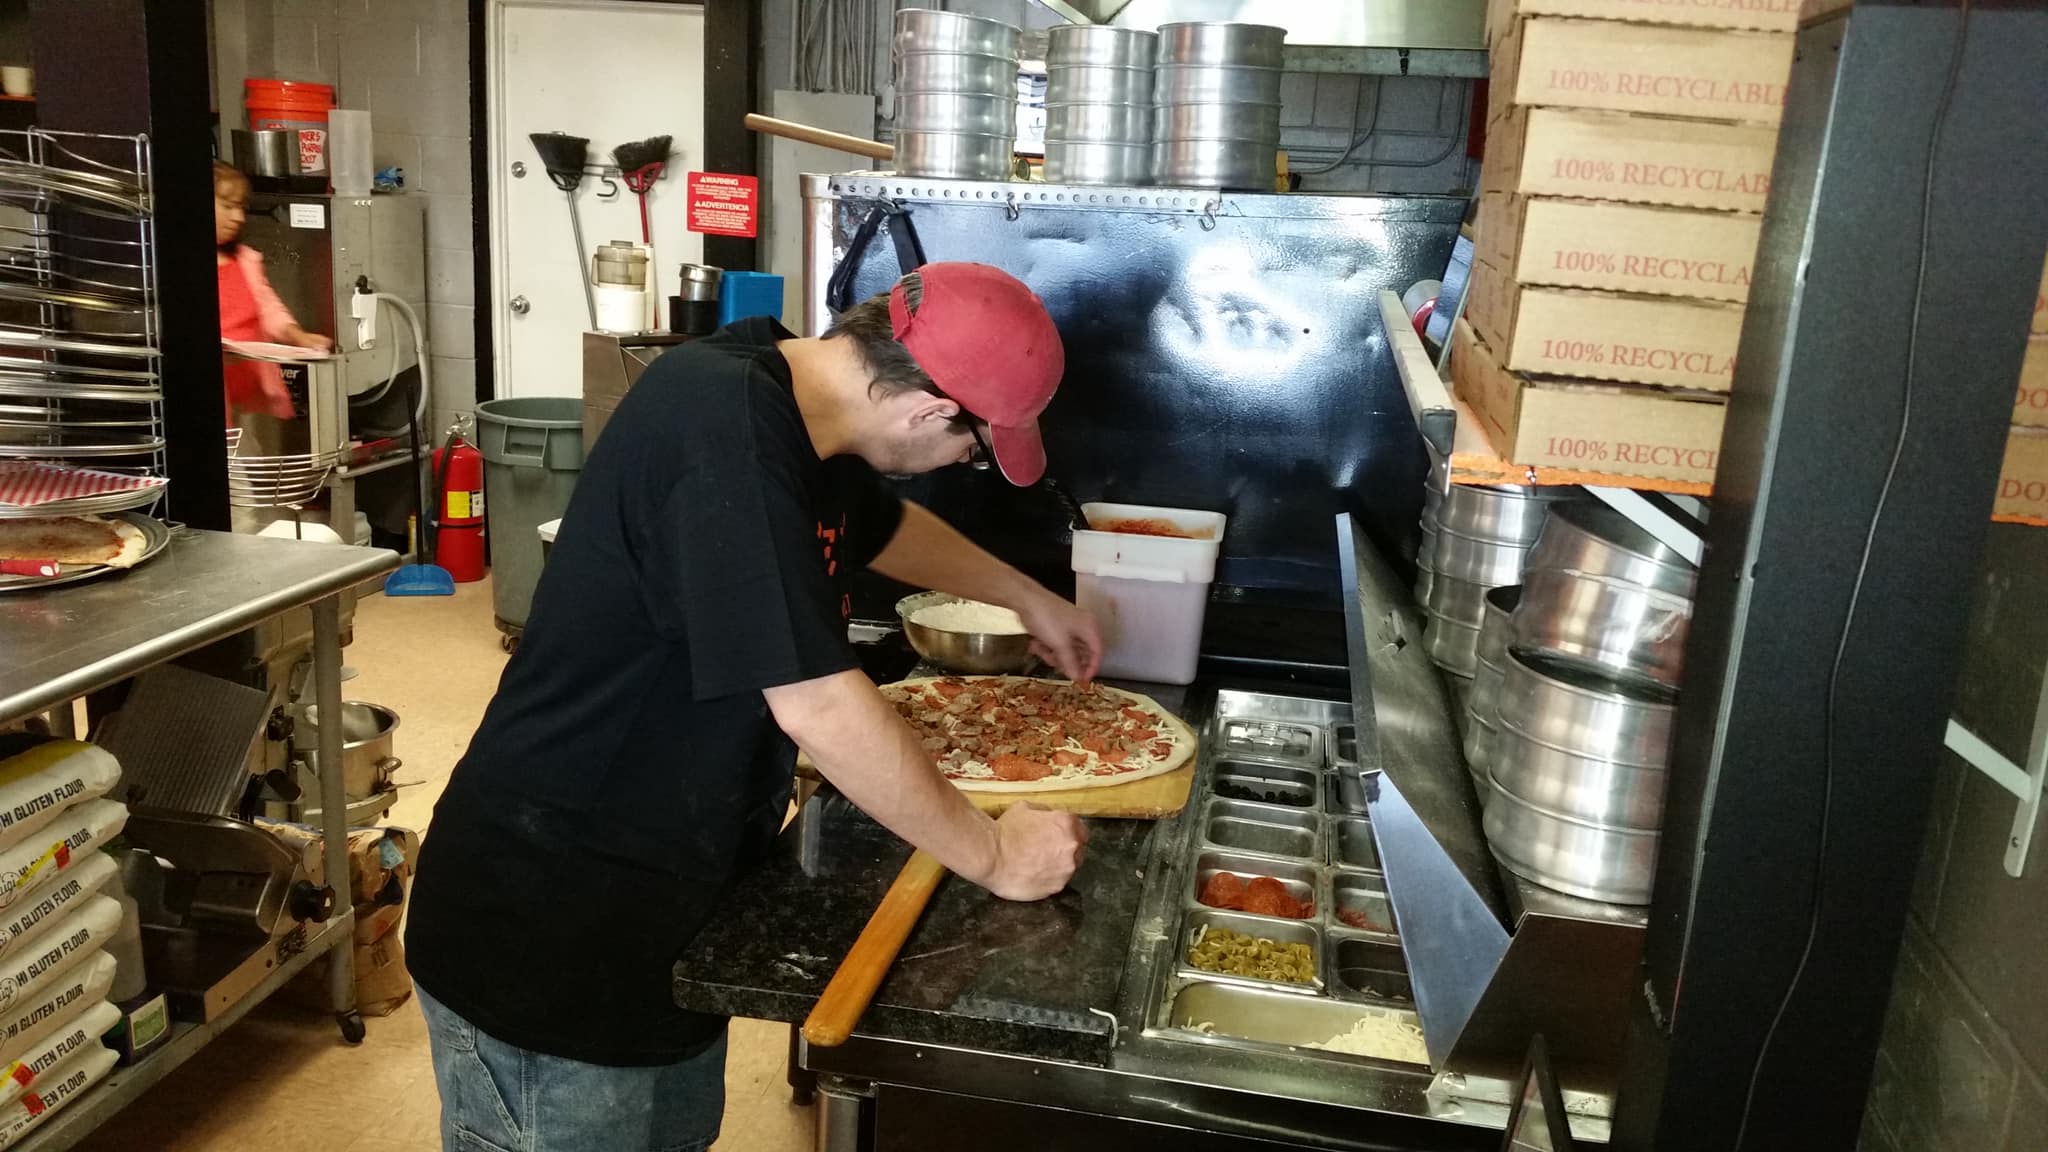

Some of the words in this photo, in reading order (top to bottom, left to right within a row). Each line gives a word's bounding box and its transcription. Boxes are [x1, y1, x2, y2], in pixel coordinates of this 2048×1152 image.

[1549, 69, 1610, 93] 100%
[1552, 158, 1615, 183] 100%
[1622, 162, 1771, 194] RECYCLAB
[1552, 250, 1616, 274] 100%
[1623, 253, 1753, 286] RECYCLA
[1541, 339, 1604, 364] 100%
[1611, 343, 1738, 375] RECYCLA
[1545, 437, 1608, 461] 100%
[1615, 441, 1719, 471] RECYCL
[2000, 479, 2048, 502] DO
[14, 792, 54, 820] GLUTEN
[55, 779, 86, 802] FLOUR
[64, 828, 92, 849] FLOUR
[9, 924, 22, 938] HI
[21, 898, 56, 931] GLUTEN
[52, 879, 82, 907] FLOUR
[16, 971, 28, 987] HI
[28, 946, 63, 979] GLUTEN
[61, 928, 90, 956] FLOUR
[8, 1024, 18, 1039] HI
[20, 1004, 55, 1031] GLUTEN
[55, 983, 84, 1010] FLOUR
[30, 1051, 57, 1075] UTEN
[56, 1029, 87, 1057] FLOUR
[59, 1070, 88, 1098] FLOUR
